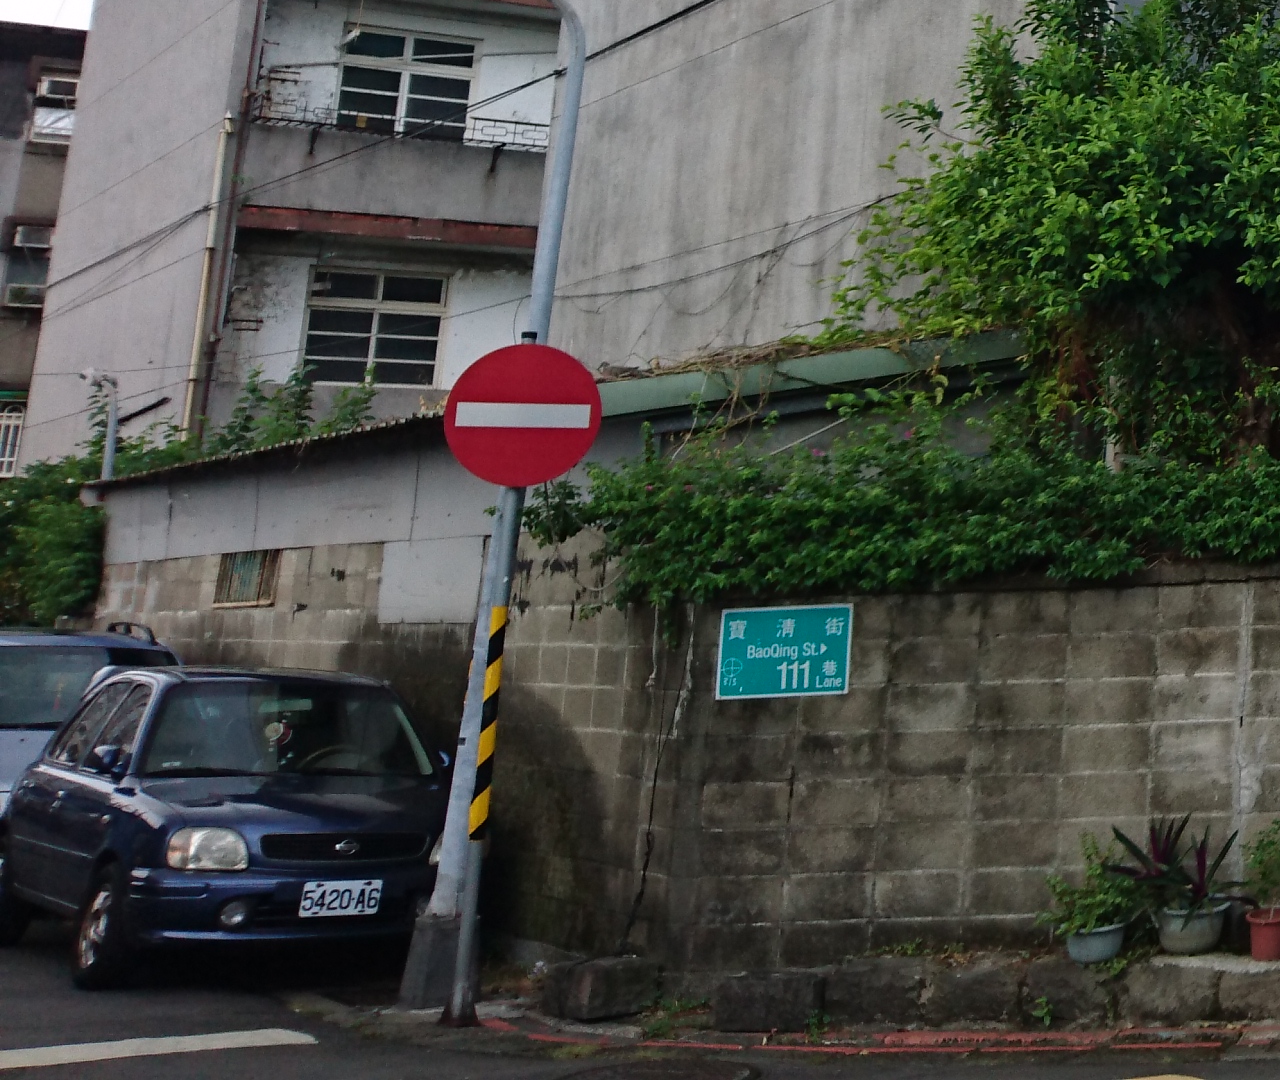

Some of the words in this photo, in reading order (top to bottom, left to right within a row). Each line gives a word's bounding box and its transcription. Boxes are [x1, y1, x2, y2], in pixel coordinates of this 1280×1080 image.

[728, 617, 845, 640] 寶清街
[747, 643, 799, 660] BaoQing
[802, 641, 819, 657] St.
[776, 660, 811, 690] 111
[822, 659, 838, 676] 巷
[815, 675, 843, 688] Lane
